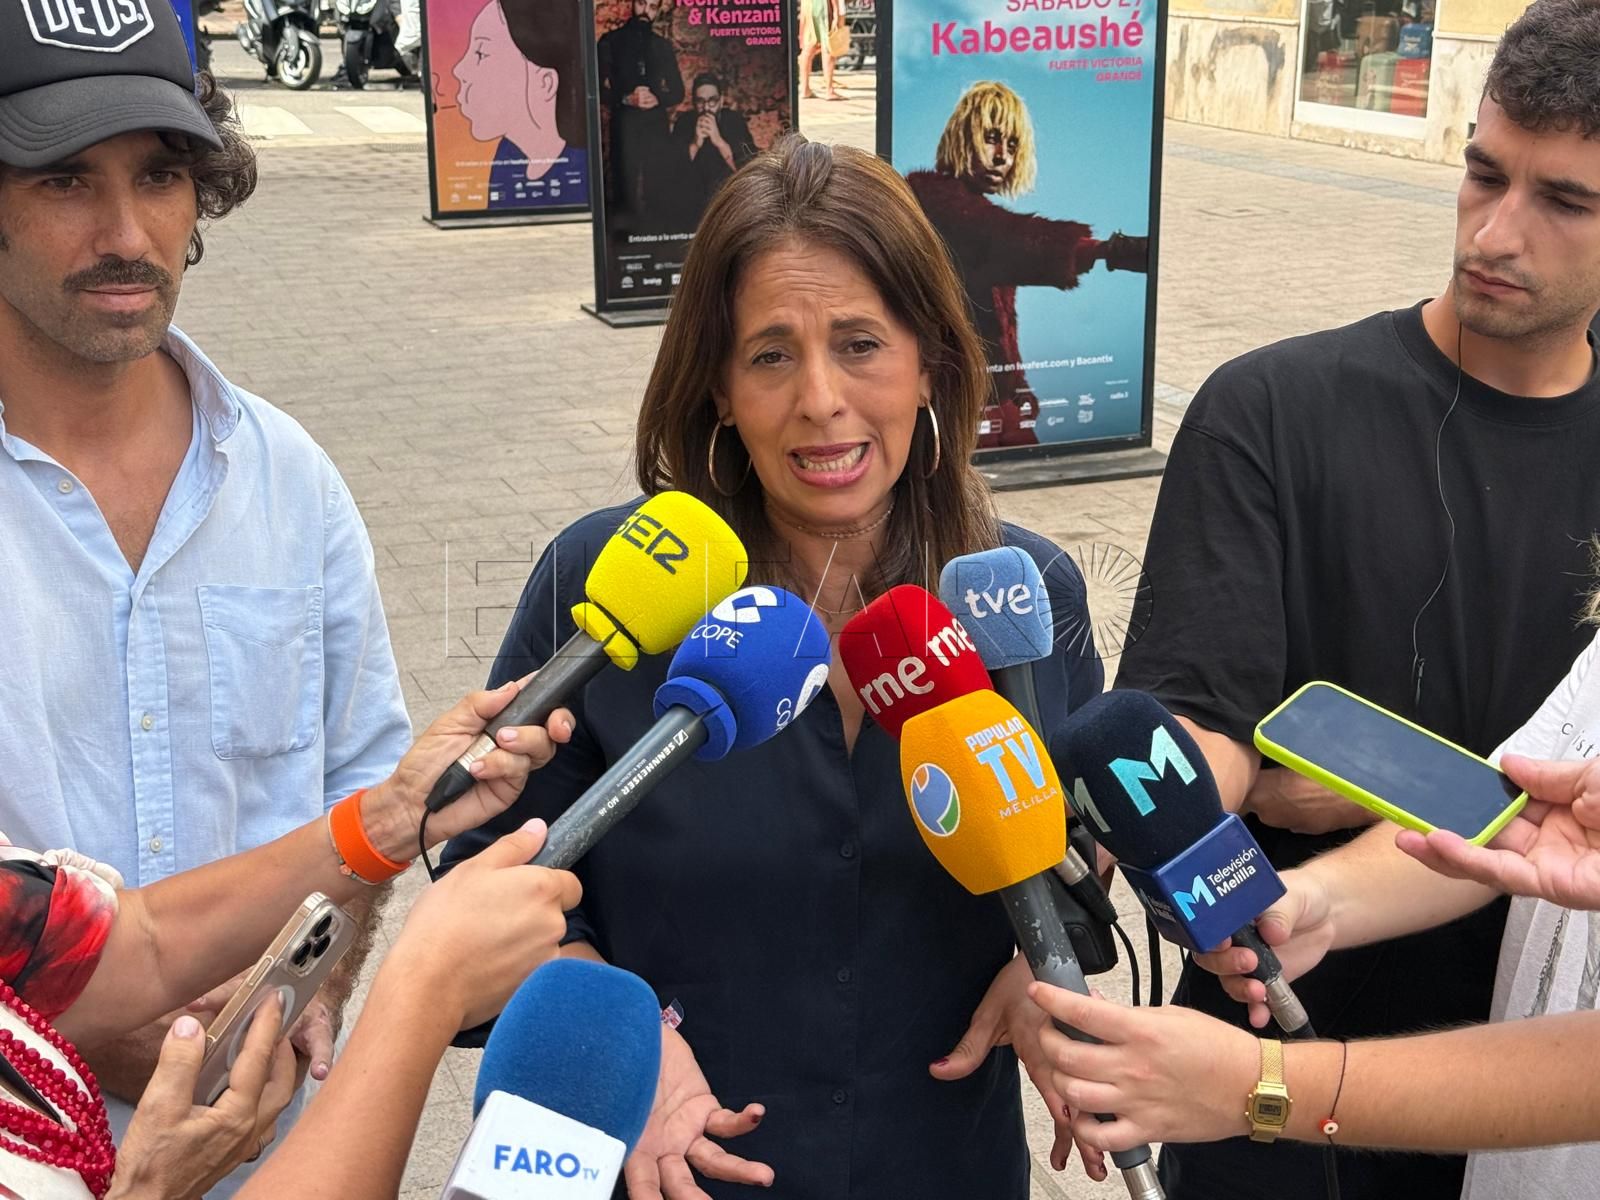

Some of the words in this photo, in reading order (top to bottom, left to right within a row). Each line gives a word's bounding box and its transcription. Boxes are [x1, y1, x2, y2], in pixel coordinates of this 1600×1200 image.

[688, 8, 702, 25] &
[706, 6, 781, 24] Kenzani
[710, 27, 740, 37] FUERTE
[741, 26, 782, 36] VICTORIA
[931, 10, 1143, 56] Kabeaushé
[745, 37, 782, 46] GRANDE
[1049, 59, 1088, 71] FUERTE
[1091, 56, 1143, 69] VICTORIA
[964, 582, 1034, 619] tve
[690, 624, 744, 649] COPE
[859, 656, 935, 715] rne
[965, 716, 1025, 752] POPULAR
[621, 741, 676, 796] SENNHEISER
[976, 731, 1047, 803] TV
[999, 787, 1058, 820] MELILLA
[1206, 847, 1258, 886] Televisión
[1216, 865, 1257, 897] Melilla
[494, 1143, 581, 1178] FARO
[583, 1167, 600, 1181] TV
